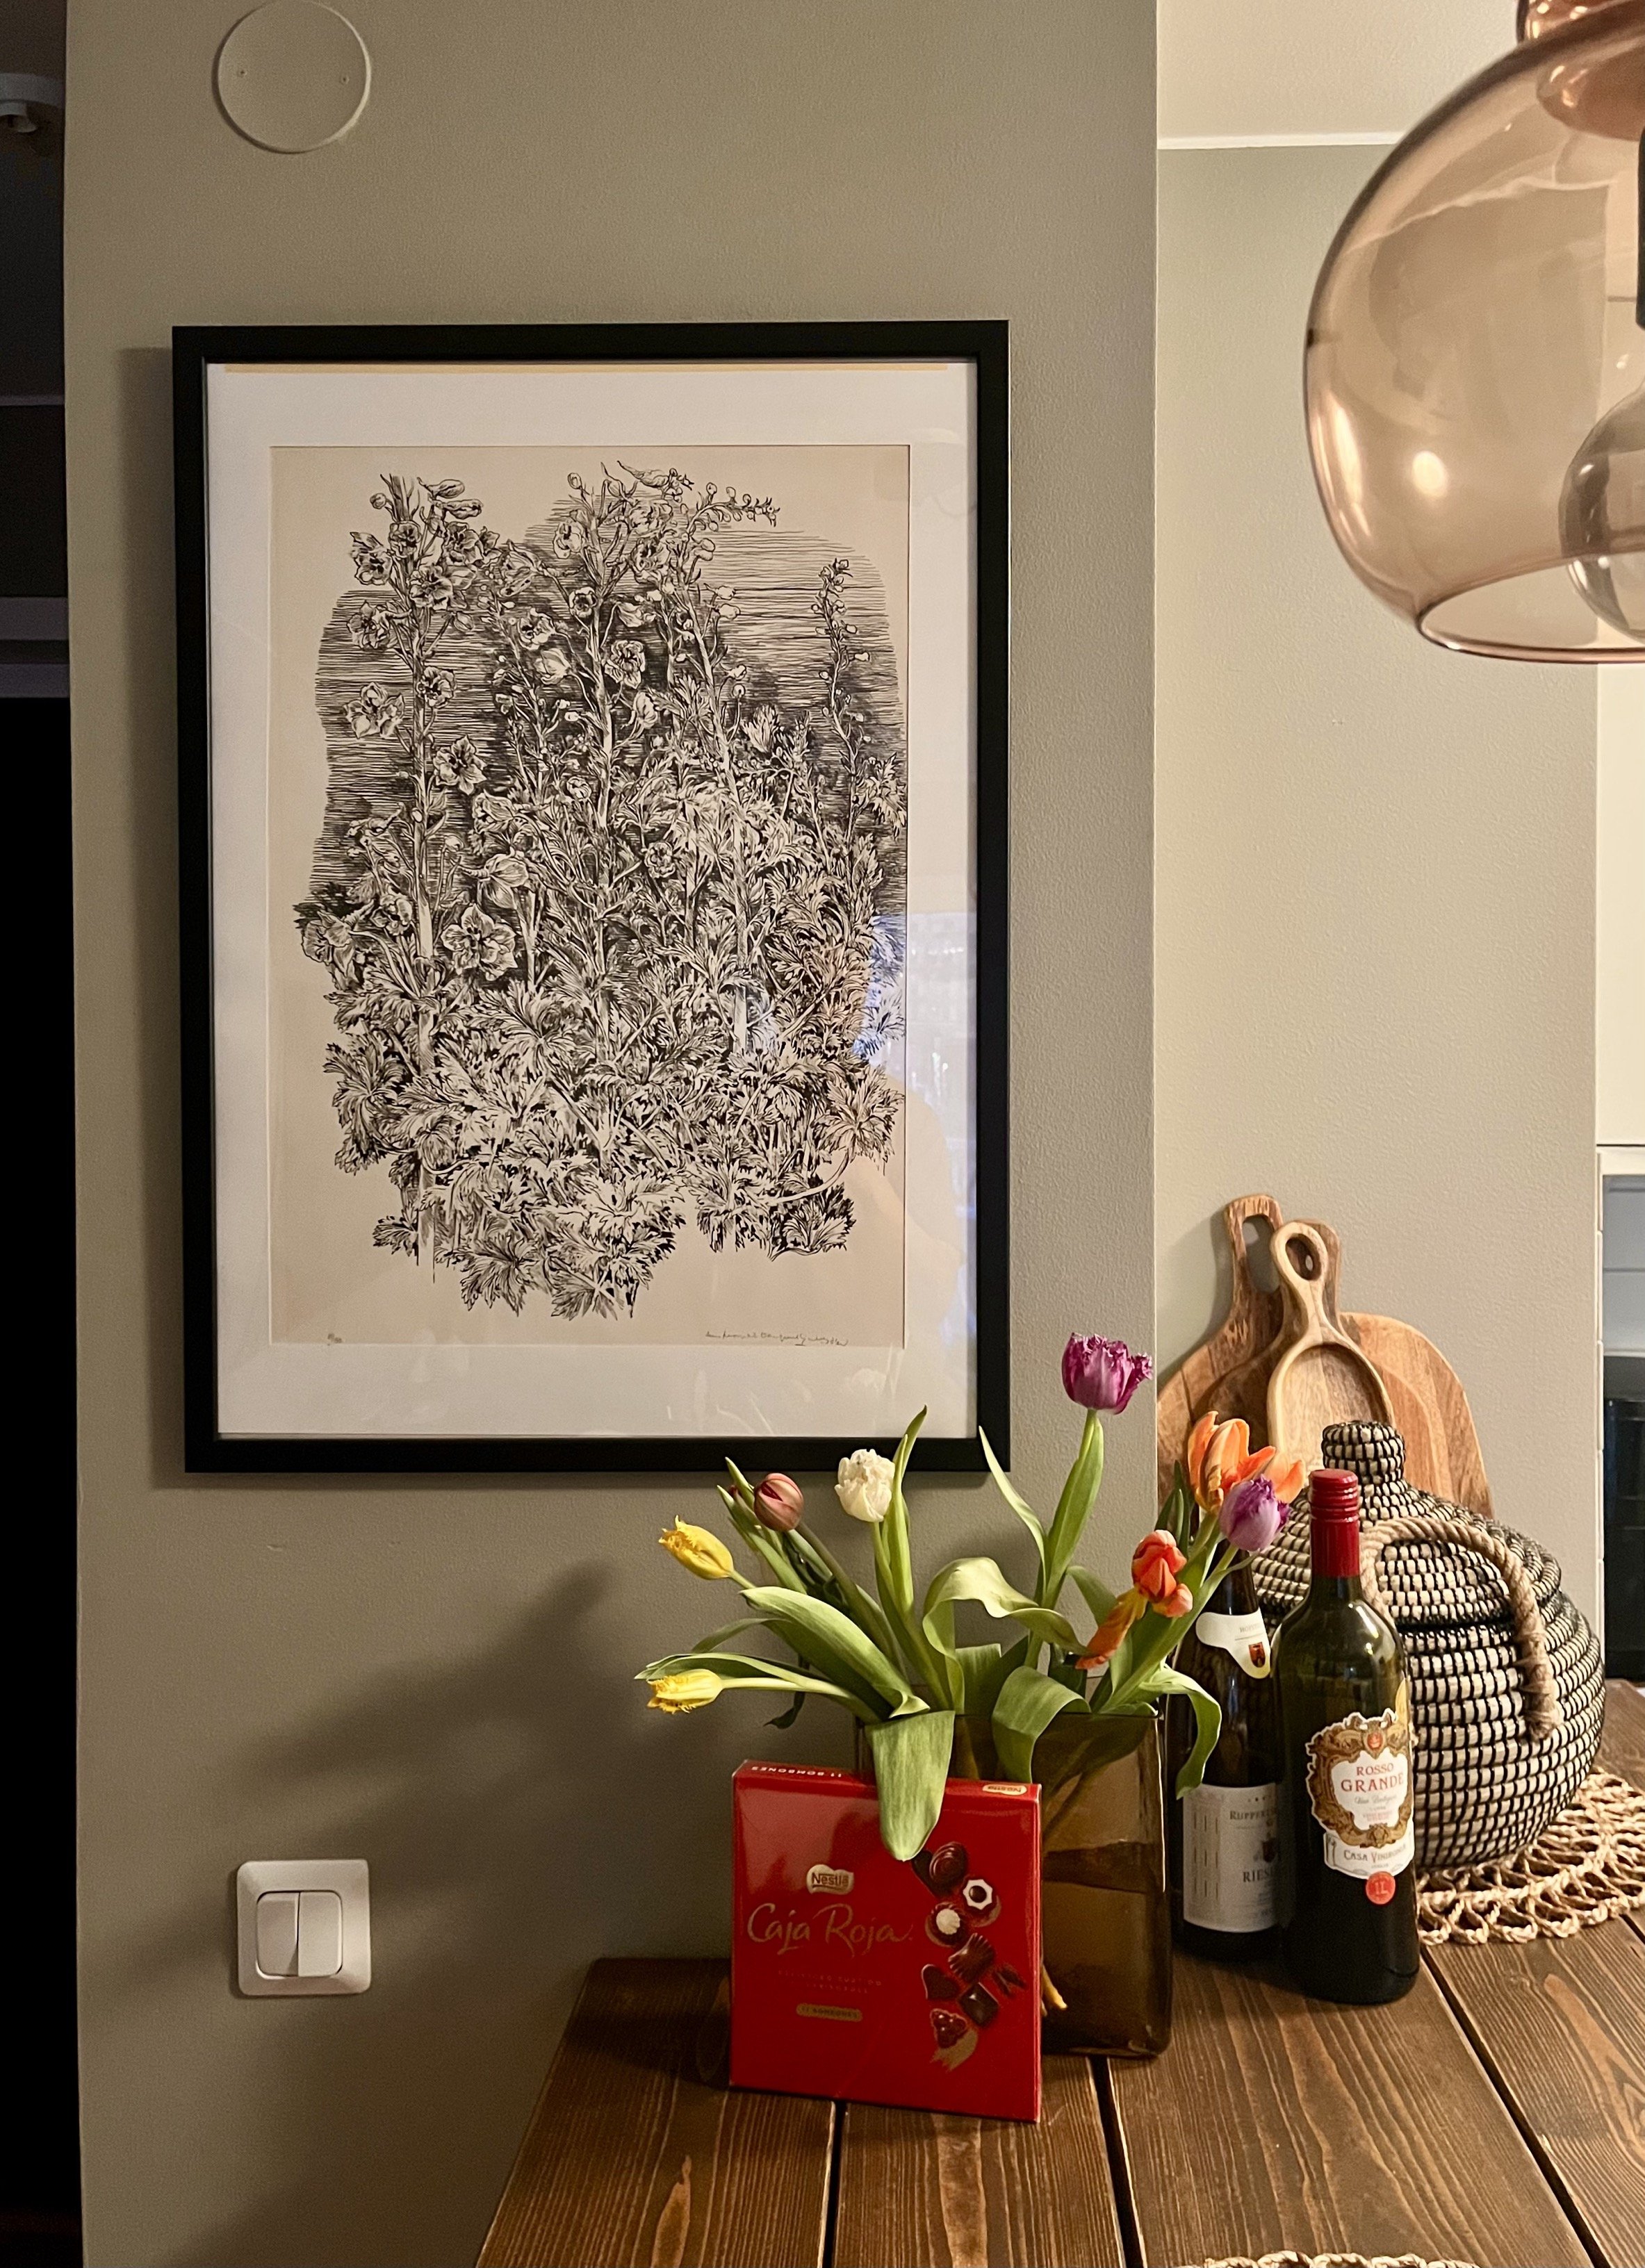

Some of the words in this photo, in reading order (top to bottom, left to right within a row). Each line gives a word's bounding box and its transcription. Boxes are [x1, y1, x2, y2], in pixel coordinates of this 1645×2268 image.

[751, 1766, 825, 1777] BOMBONES
[1356, 1763, 1394, 1776] ROSSO
[1341, 1773, 1404, 1793] GRANDE
[1343, 1849, 1368, 1862] CASA
[747, 1903, 810, 1955] Caja
[812, 1903, 913, 1958] Roja
